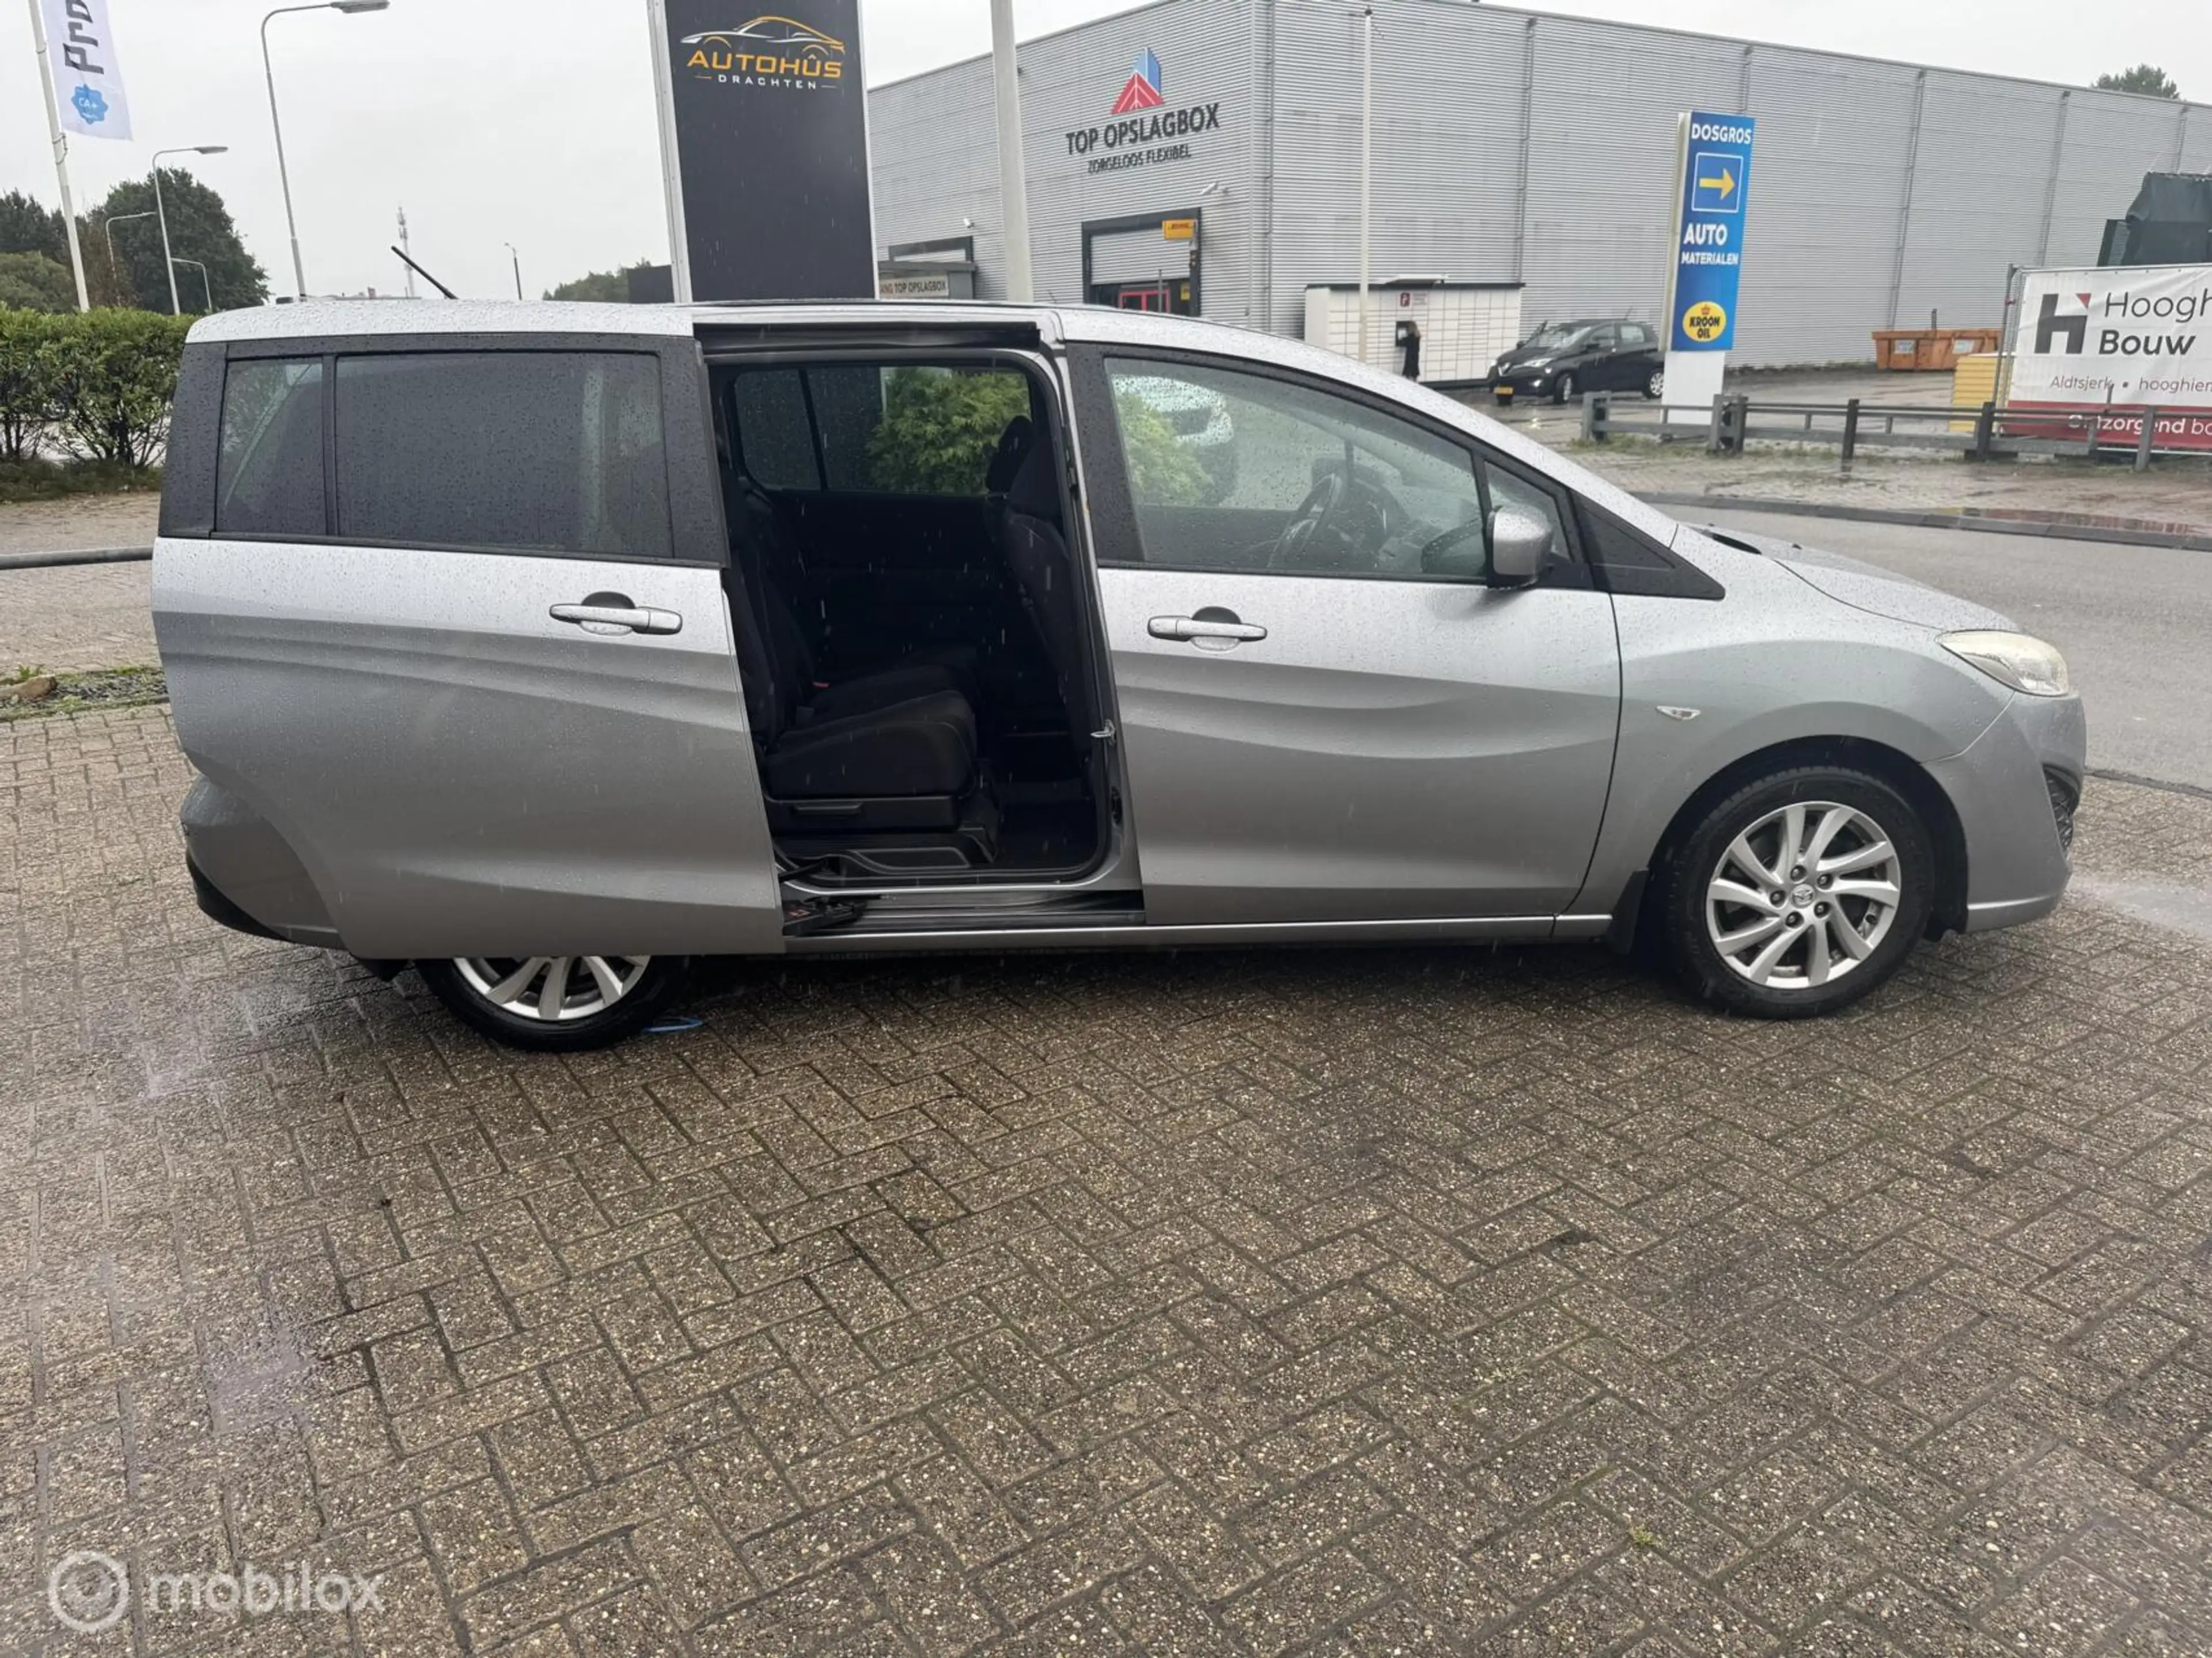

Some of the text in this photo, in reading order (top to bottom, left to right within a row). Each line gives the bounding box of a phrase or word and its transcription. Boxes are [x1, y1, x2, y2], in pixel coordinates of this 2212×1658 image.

[687, 50, 843, 78] AUTOHÛS
[718, 74, 816, 89] DRACHTEN
[1066, 103, 1220, 155] TOP OPSLAGBOX
[1691, 123, 1752, 145] DOSGROS
[1088, 144, 1192, 173] ZORGELOOS FLEXIBEL
[1683, 223, 1728, 246] AUTO
[1681, 251, 1739, 265] MATERIALEN
[1689, 316, 1721, 328] KROON
[1696, 328, 1711, 339] OIL
[2099, 329, 2196, 355] Bouw
